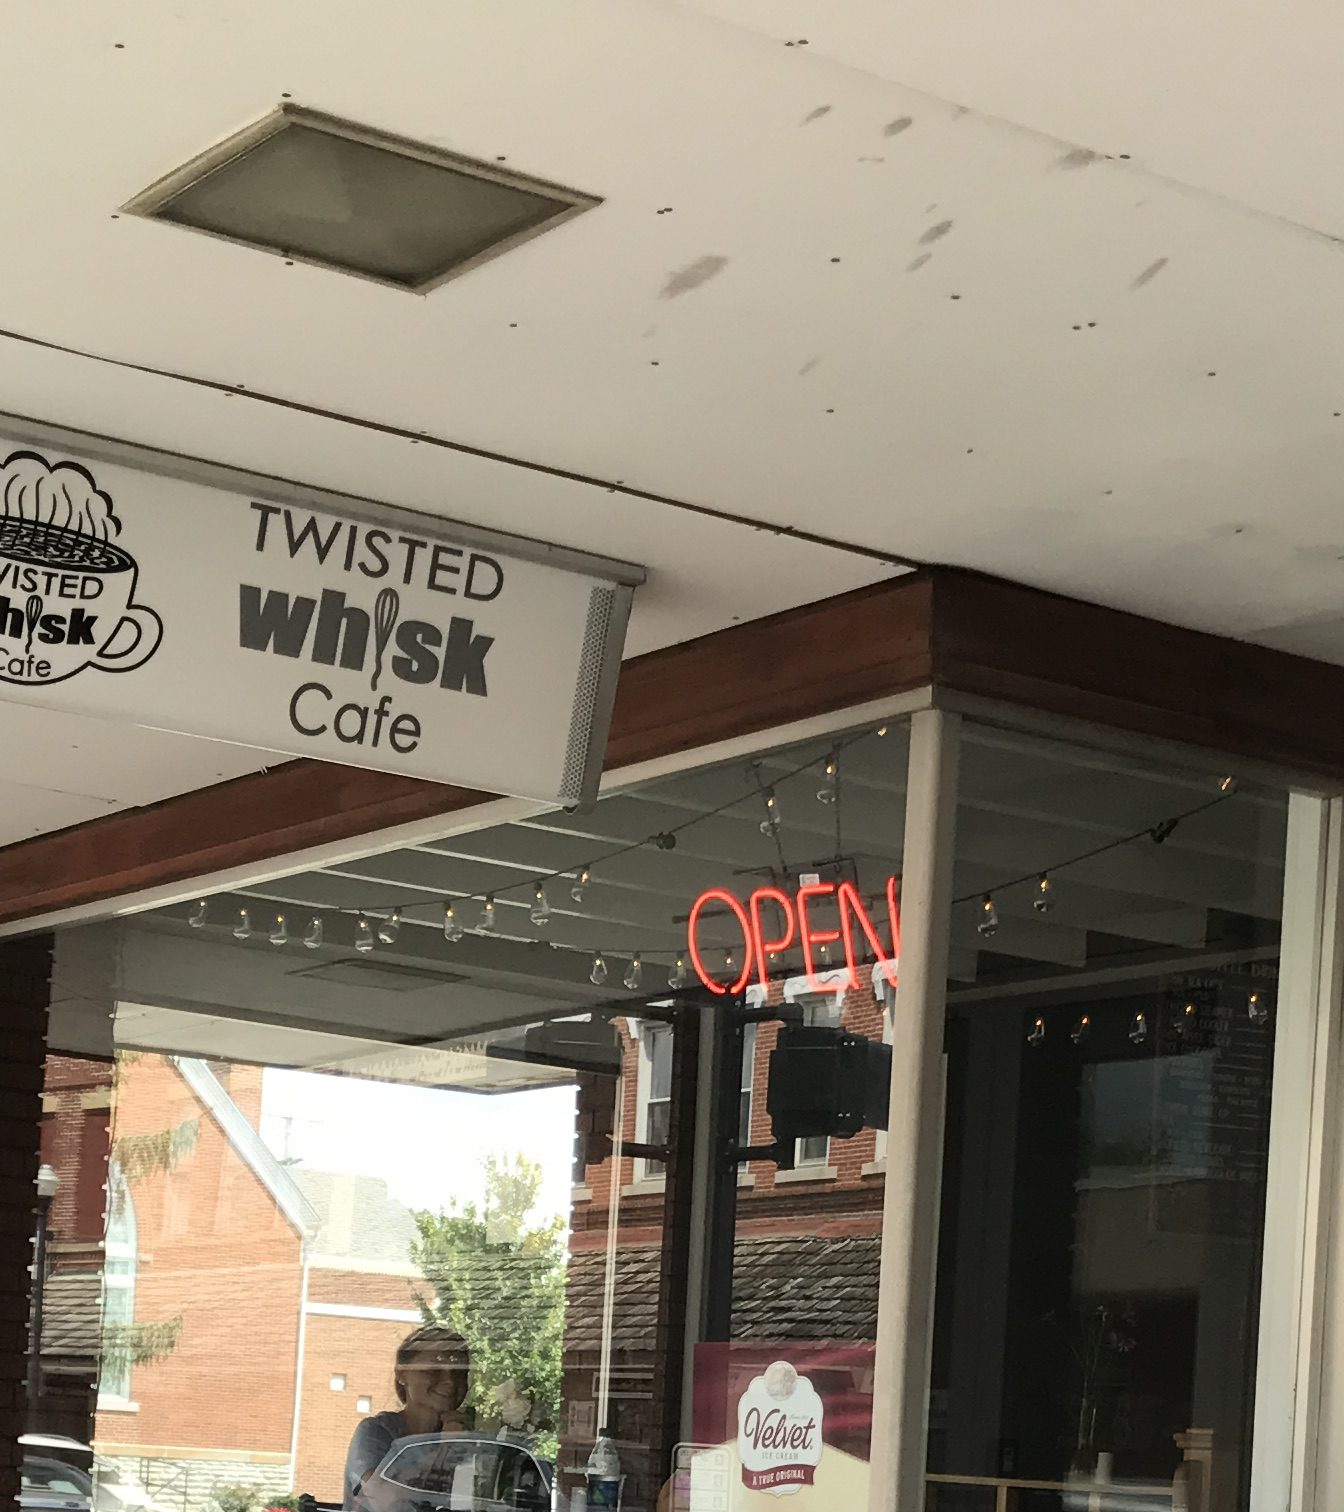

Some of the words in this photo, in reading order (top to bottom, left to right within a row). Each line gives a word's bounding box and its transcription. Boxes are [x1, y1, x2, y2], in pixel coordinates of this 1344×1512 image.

[250, 502, 504, 602] TWISTED
[289, 682, 421, 753] Cafe
[688, 876, 900, 994] OPEN
[744, 1407, 815, 1450] Velvet
[762, 1452, 772, 1460] ICE
[776, 1452, 798, 1460] CREAM
[752, 1476, 756, 1485] A
[759, 1474, 774, 1485] TRUE
[776, 1470, 804, 1481] ORIGINAL
